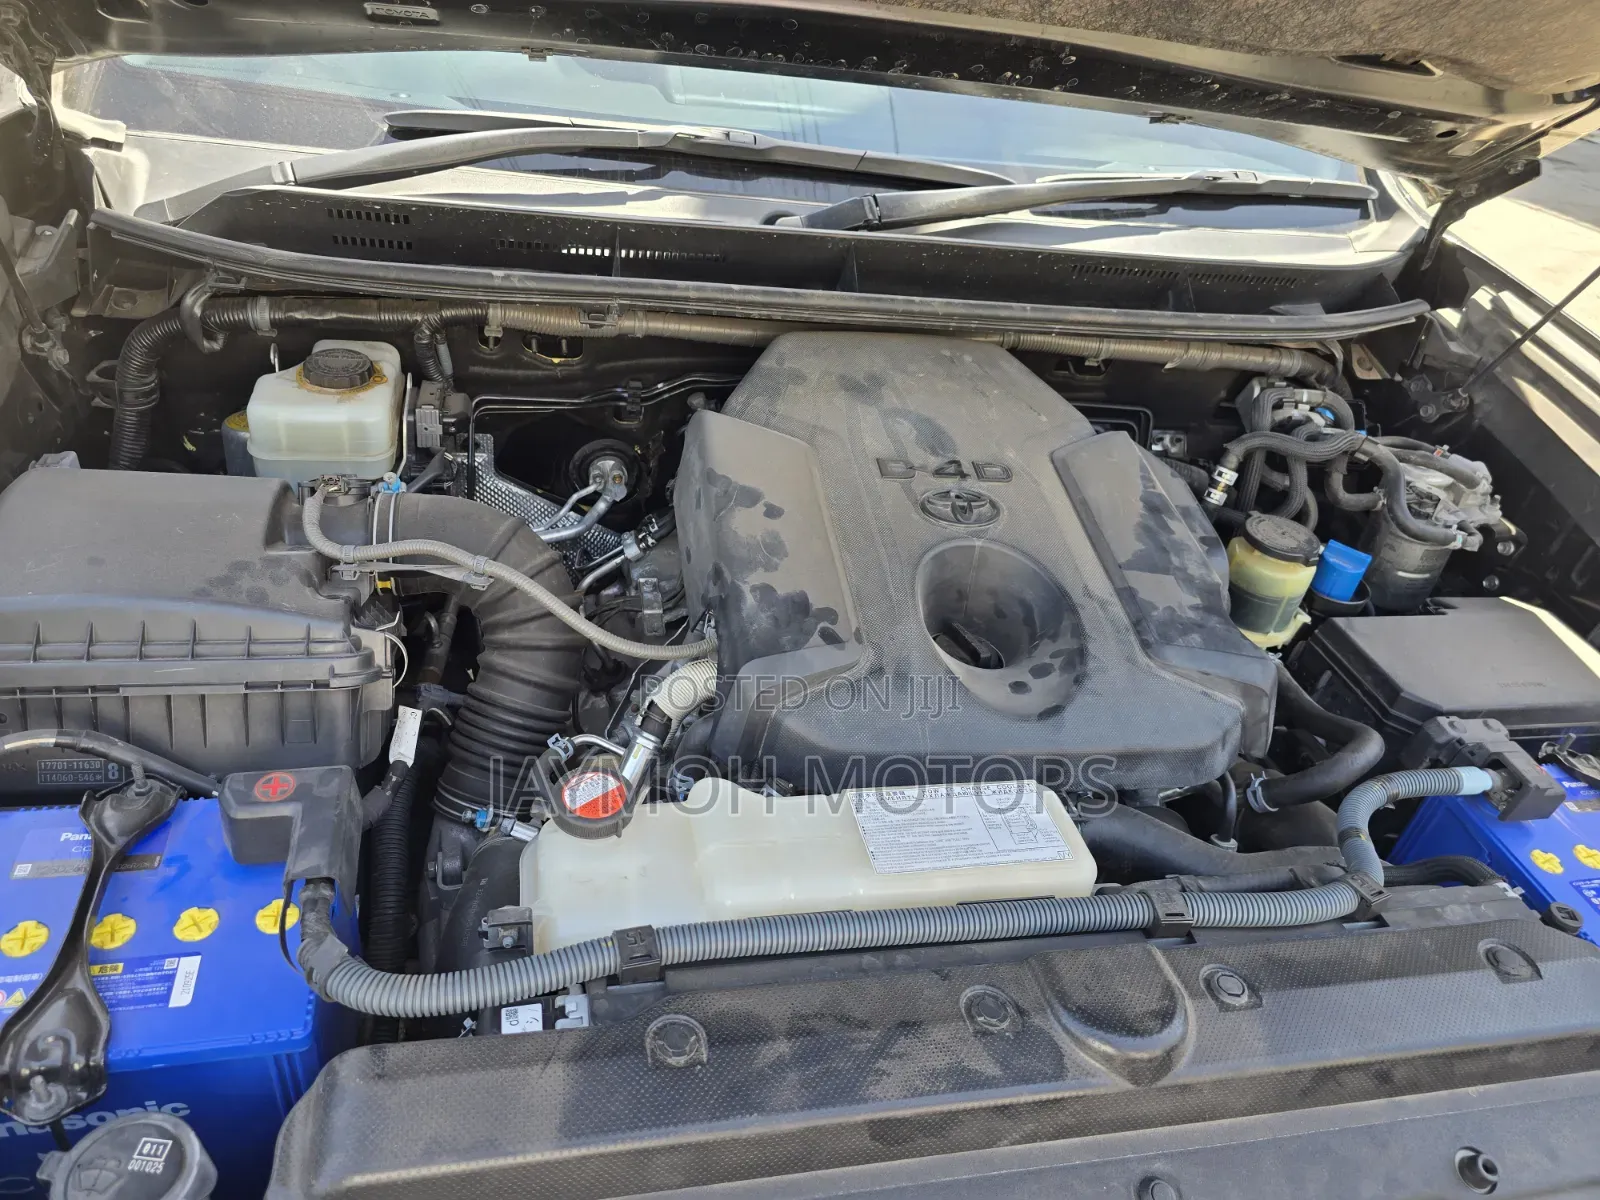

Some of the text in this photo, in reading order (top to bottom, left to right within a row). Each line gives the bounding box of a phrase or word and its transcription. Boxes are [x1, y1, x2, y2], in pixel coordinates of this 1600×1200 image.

[375, 7, 430, 18] TOYOTA
[876, 457, 1014, 483] D-4D
[107, 762, 119, 780] 8
